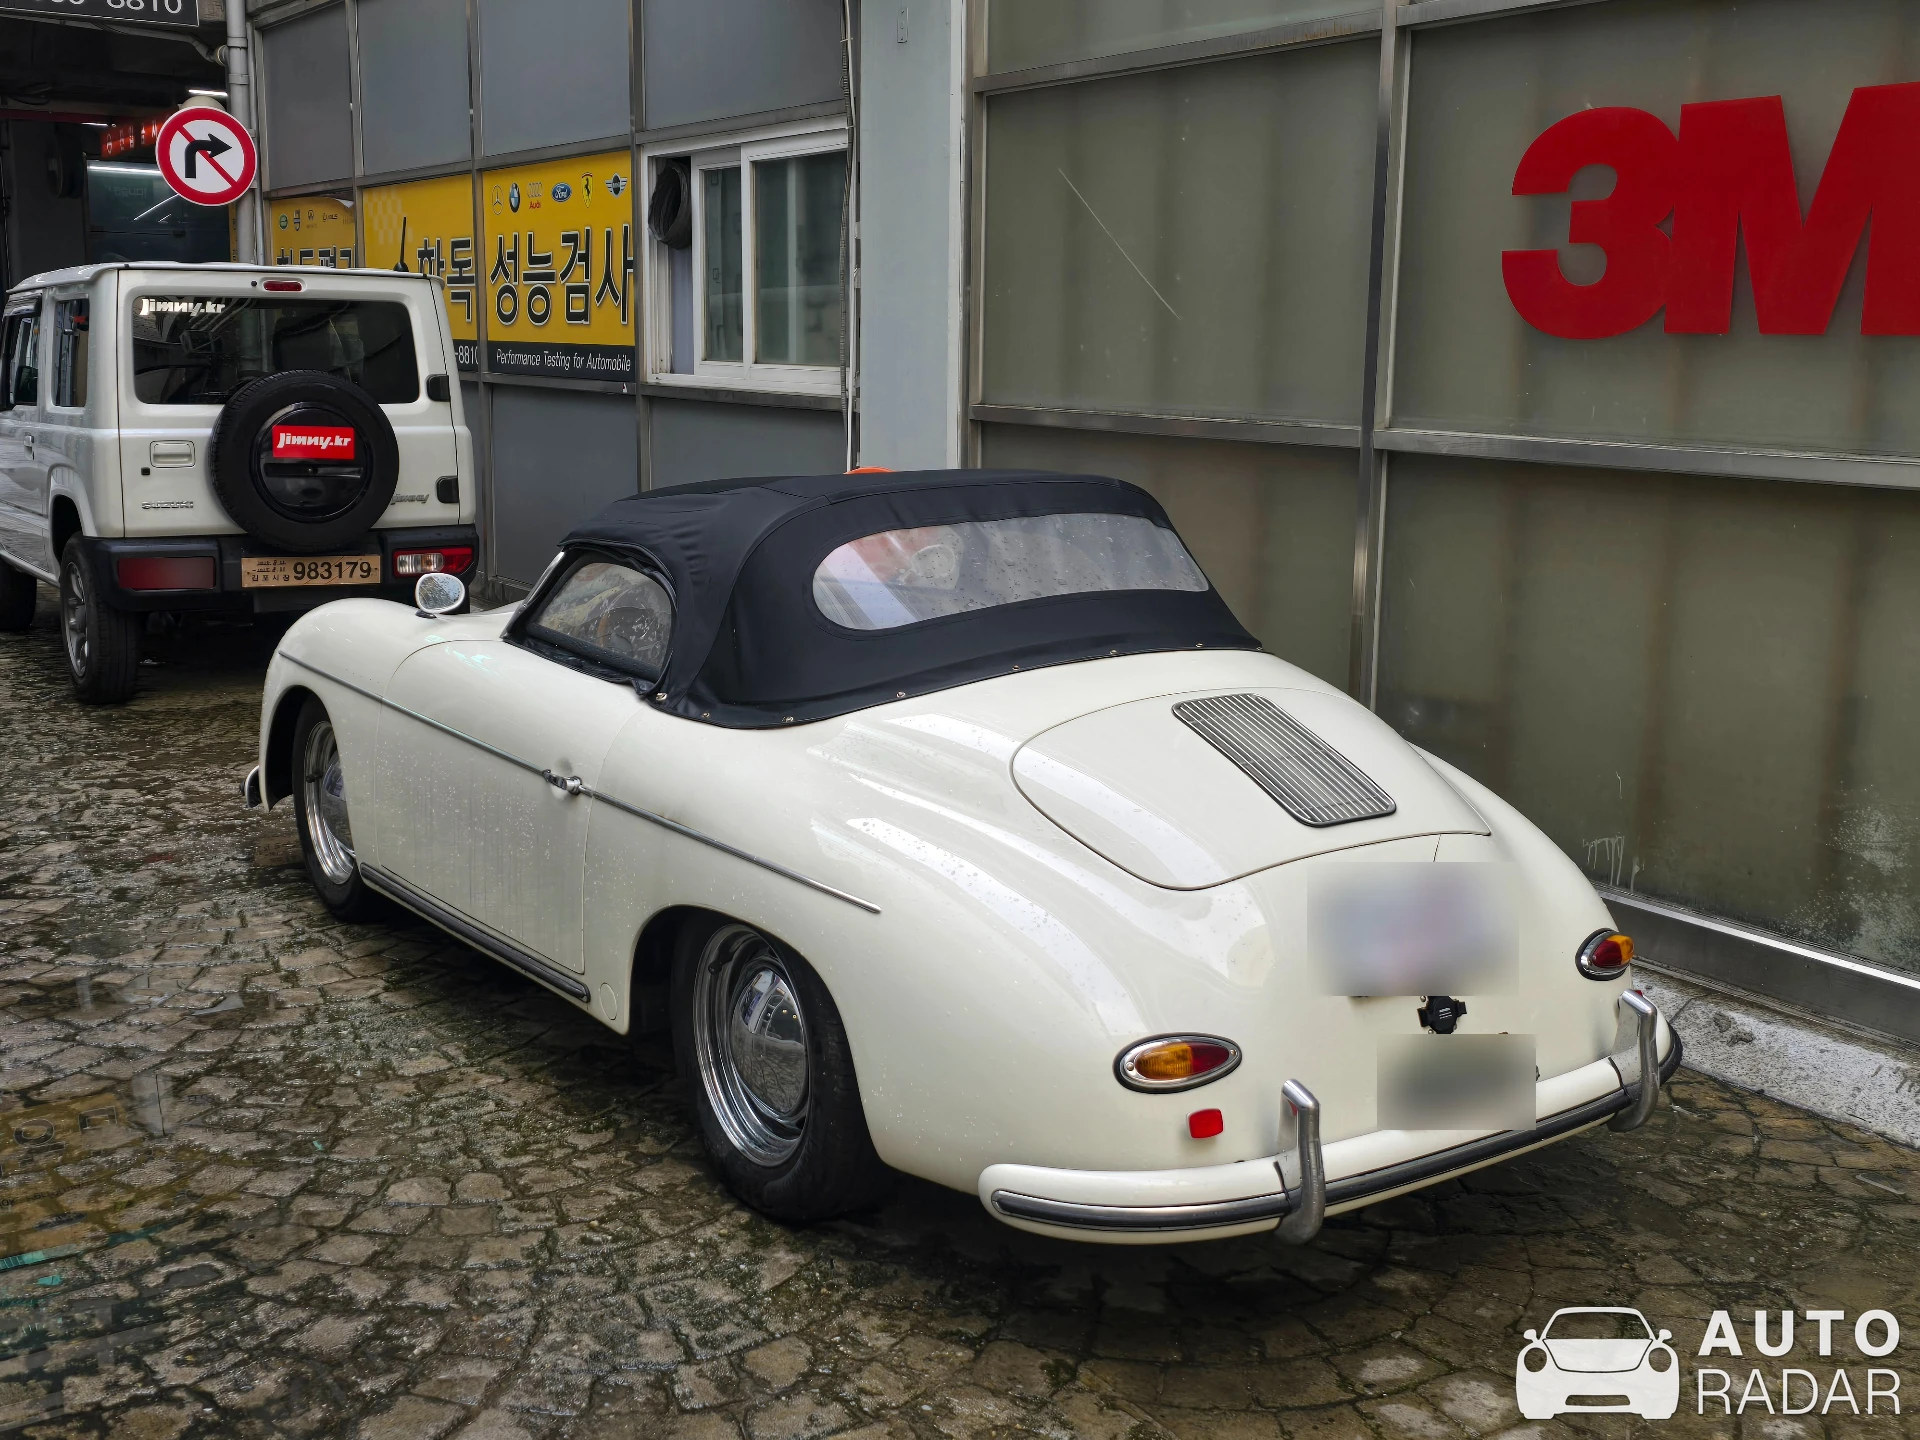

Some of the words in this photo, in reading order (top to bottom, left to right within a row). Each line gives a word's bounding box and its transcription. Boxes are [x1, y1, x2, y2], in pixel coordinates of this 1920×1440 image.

[554, 185, 568, 199] Ford
[529, 201, 541, 209] Audi
[1502, 81, 1920, 339] 3M
[489, 222, 634, 327] 성능검사
[139, 298, 226, 317] Jimny.kr
[496, 348, 540, 366] Performance
[544, 350, 570, 370] Testing
[573, 352, 584, 369] for
[586, 352, 631, 371] Automobile
[277, 432, 351, 450] Jimny.kr
[293, 561, 371, 581] 983179
